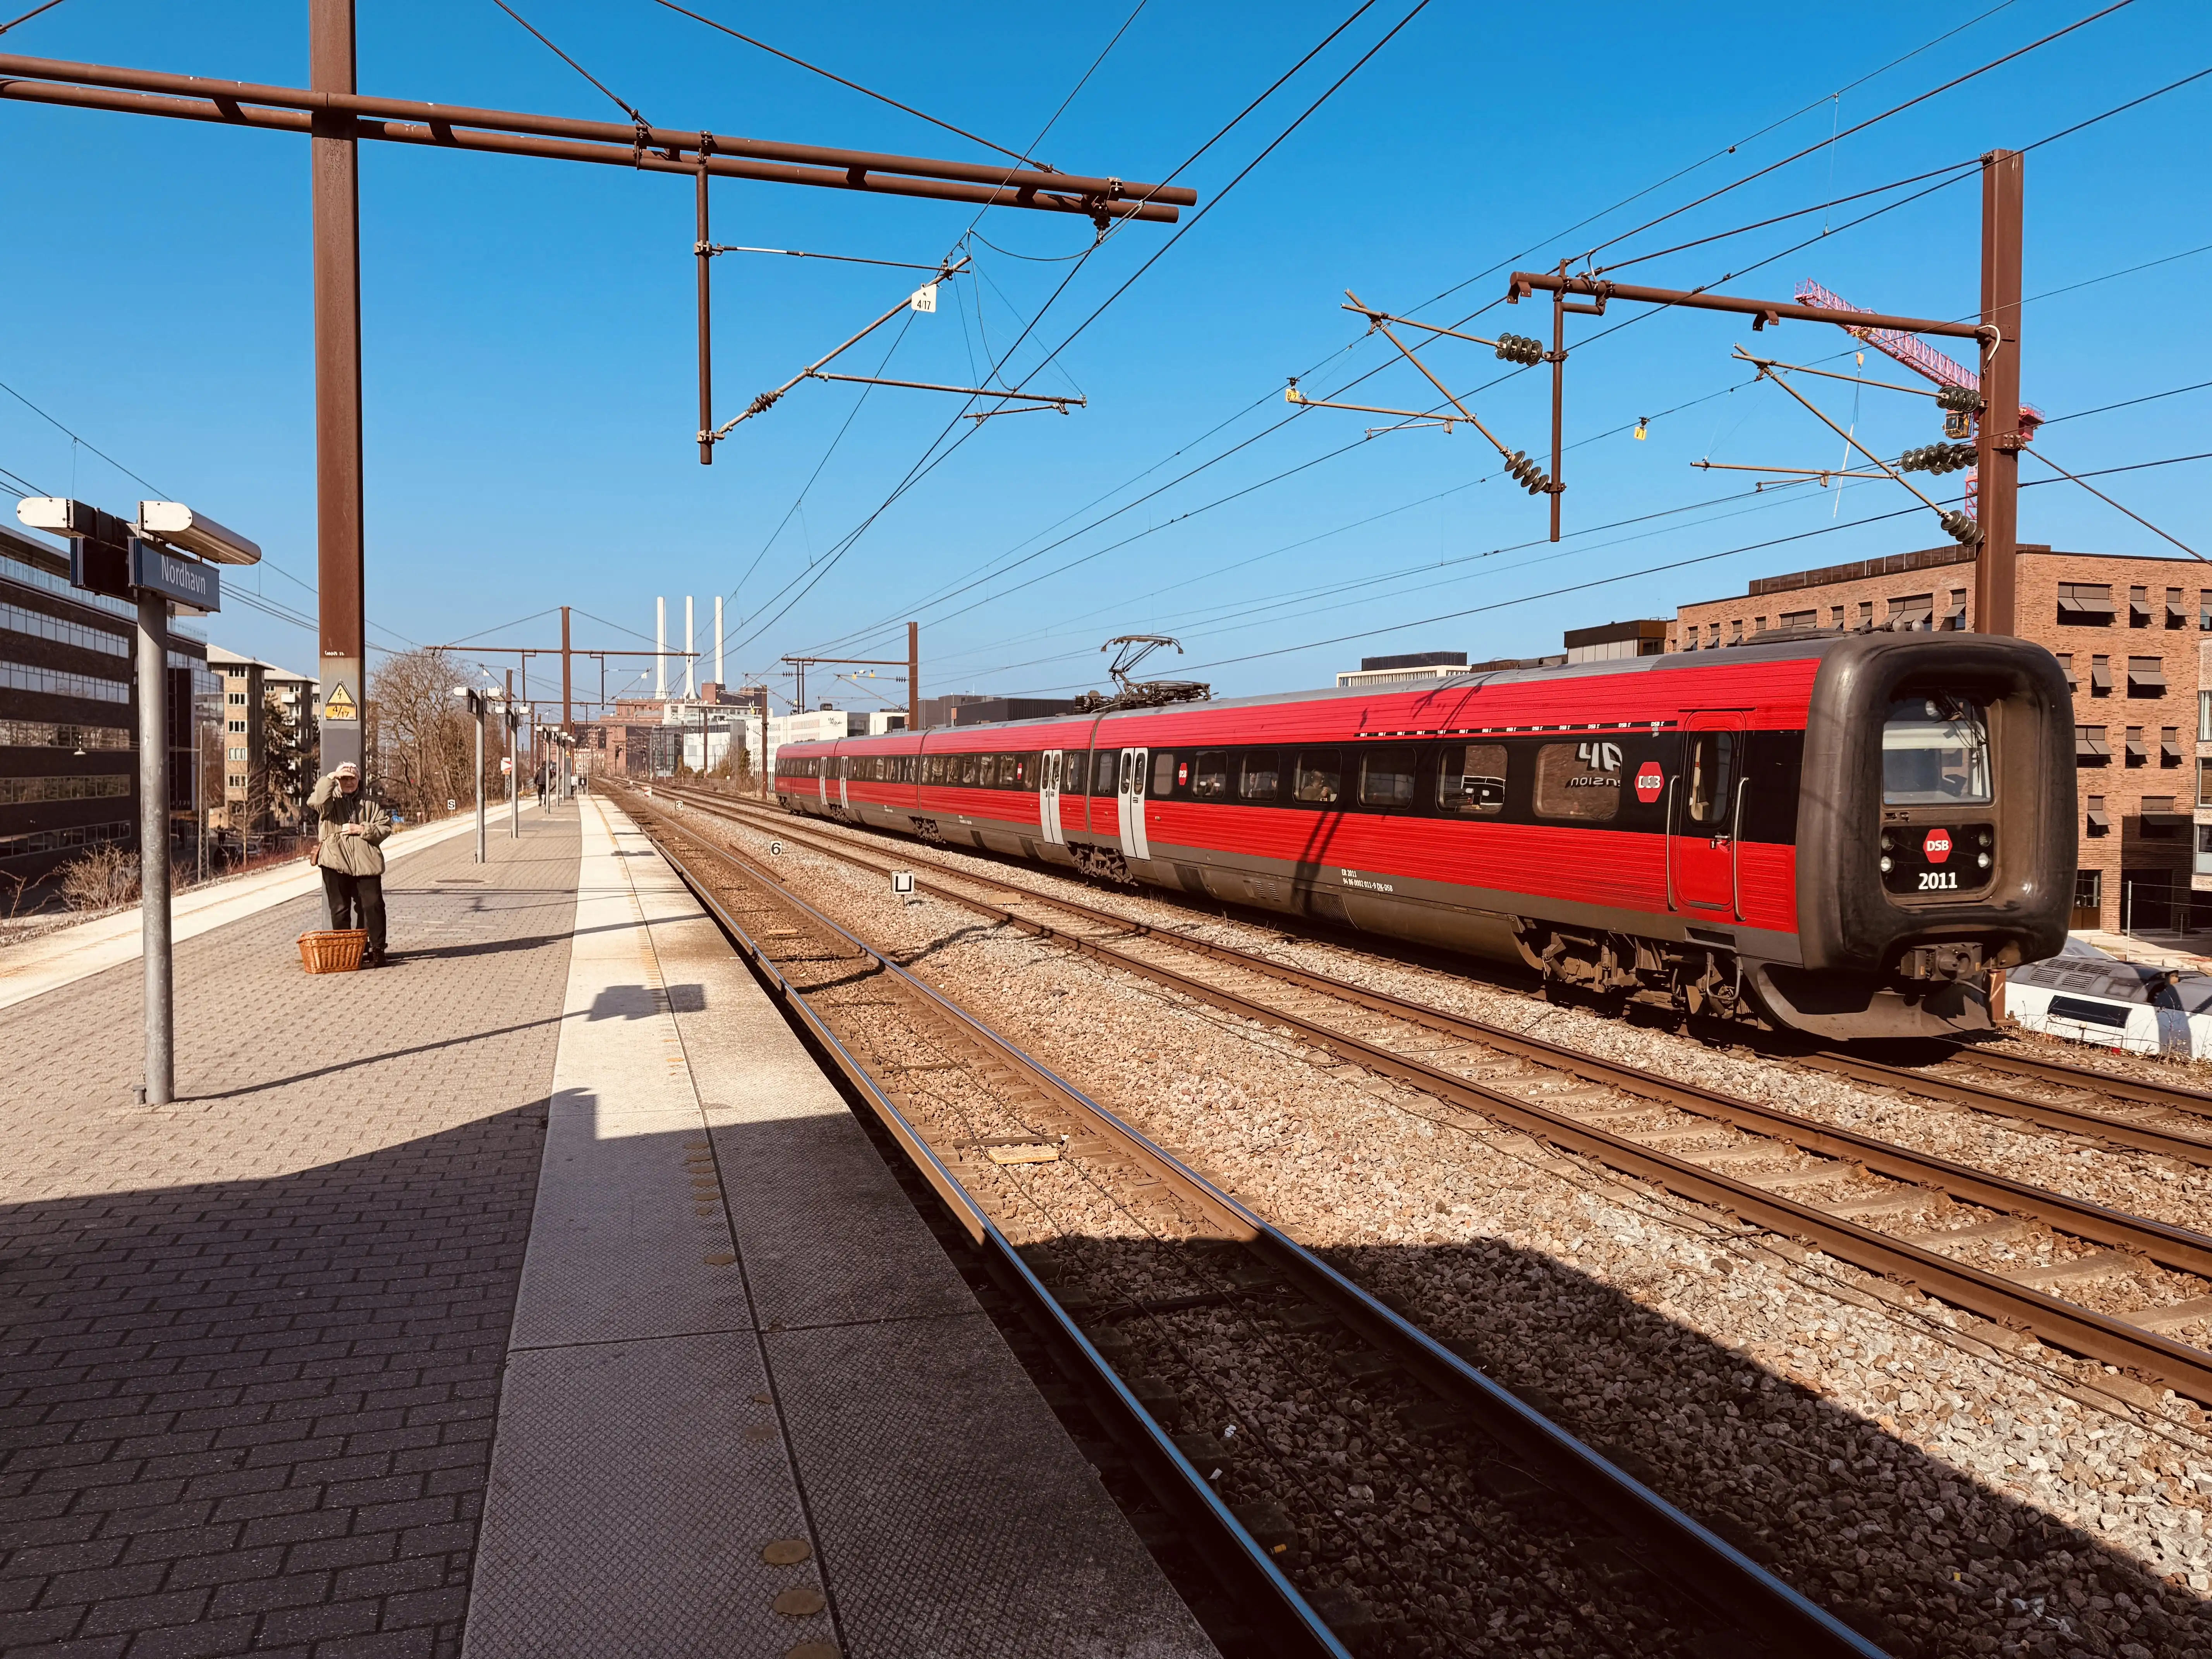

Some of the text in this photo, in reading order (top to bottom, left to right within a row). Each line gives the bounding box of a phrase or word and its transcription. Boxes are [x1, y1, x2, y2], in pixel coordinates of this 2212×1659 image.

[917, 299, 931, 310] 4/17
[161, 555, 206, 595] Nordhavn
[332, 706, 349, 718] 4/17
[771, 842, 781, 855] 6
[1927, 839, 1949, 852] DSB
[1347, 869, 1357, 878] 2011
[1364, 881, 1376, 889] 011-9
[1376, 883, 1393, 892] DK-DSB
[1918, 872, 1958, 890] 2011
